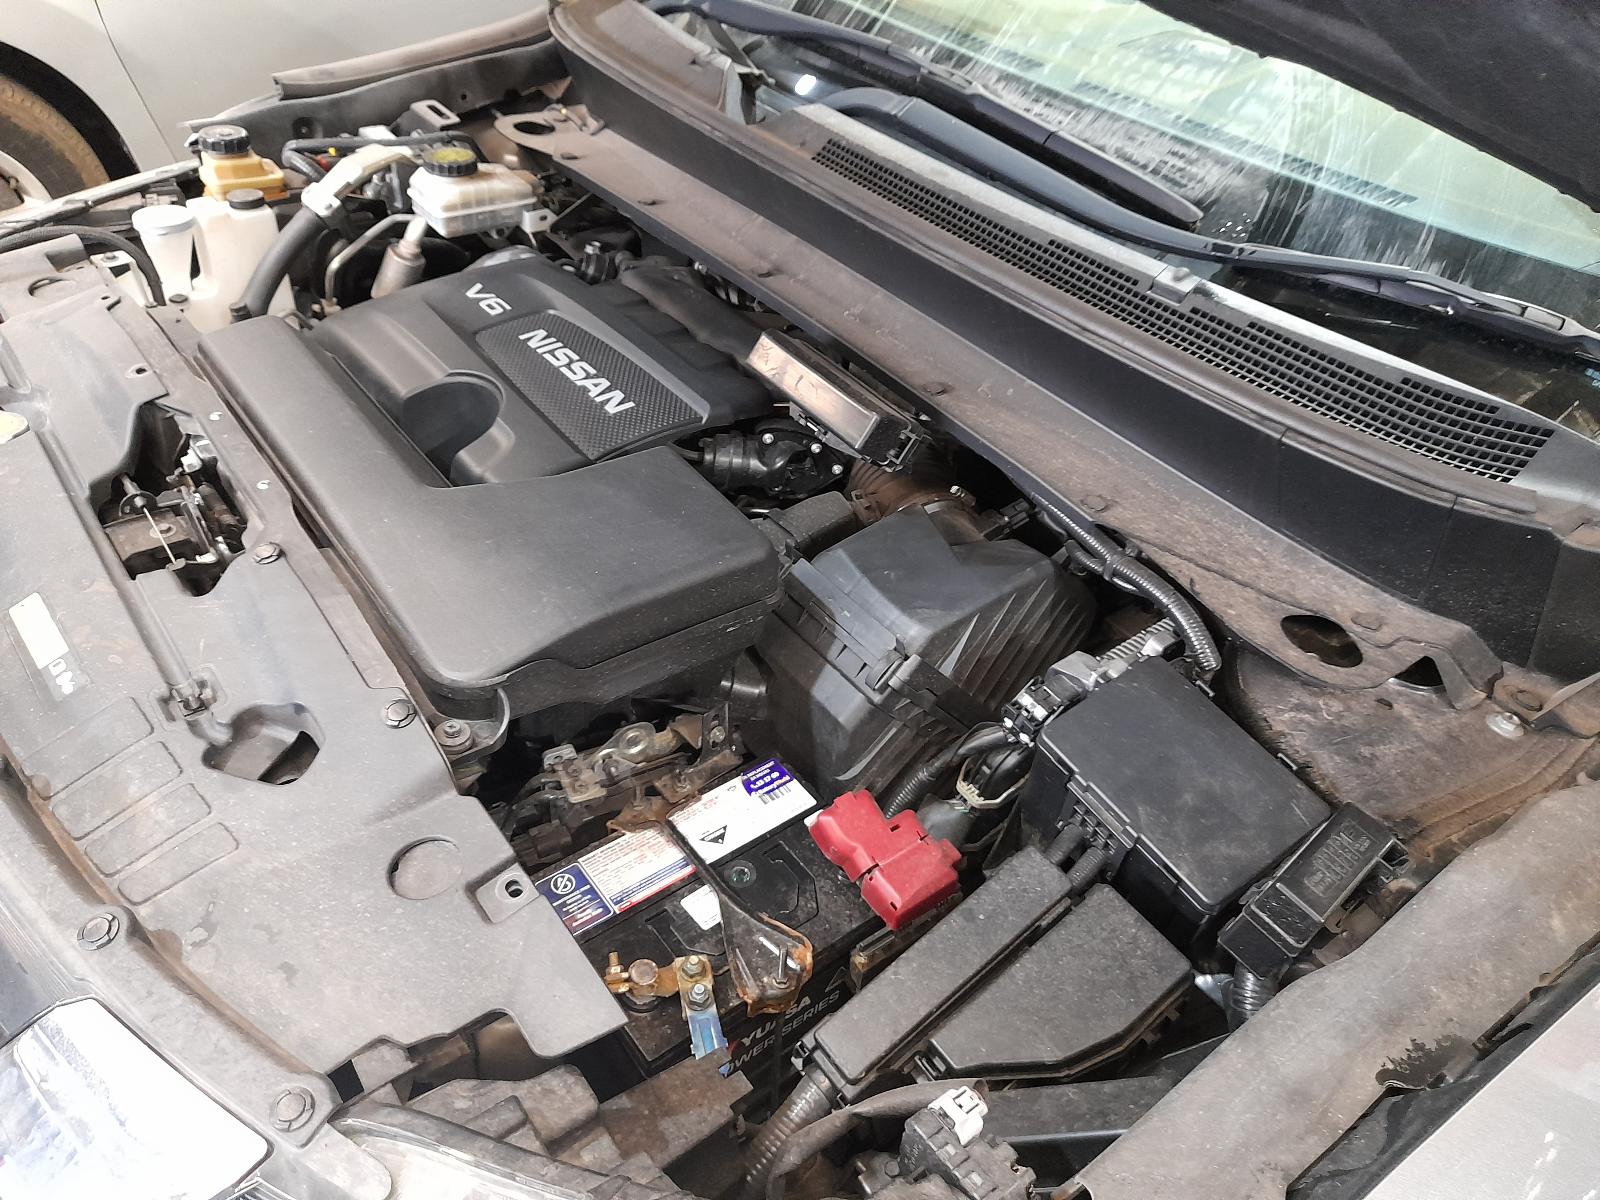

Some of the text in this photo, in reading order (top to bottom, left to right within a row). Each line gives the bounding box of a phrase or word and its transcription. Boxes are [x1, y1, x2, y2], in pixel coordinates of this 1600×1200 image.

[465, 282, 512, 316] V6
[518, 328, 636, 414] NISSAN
[741, 996, 811, 1047] YUSA
[781, 990, 840, 1037] SERIES
